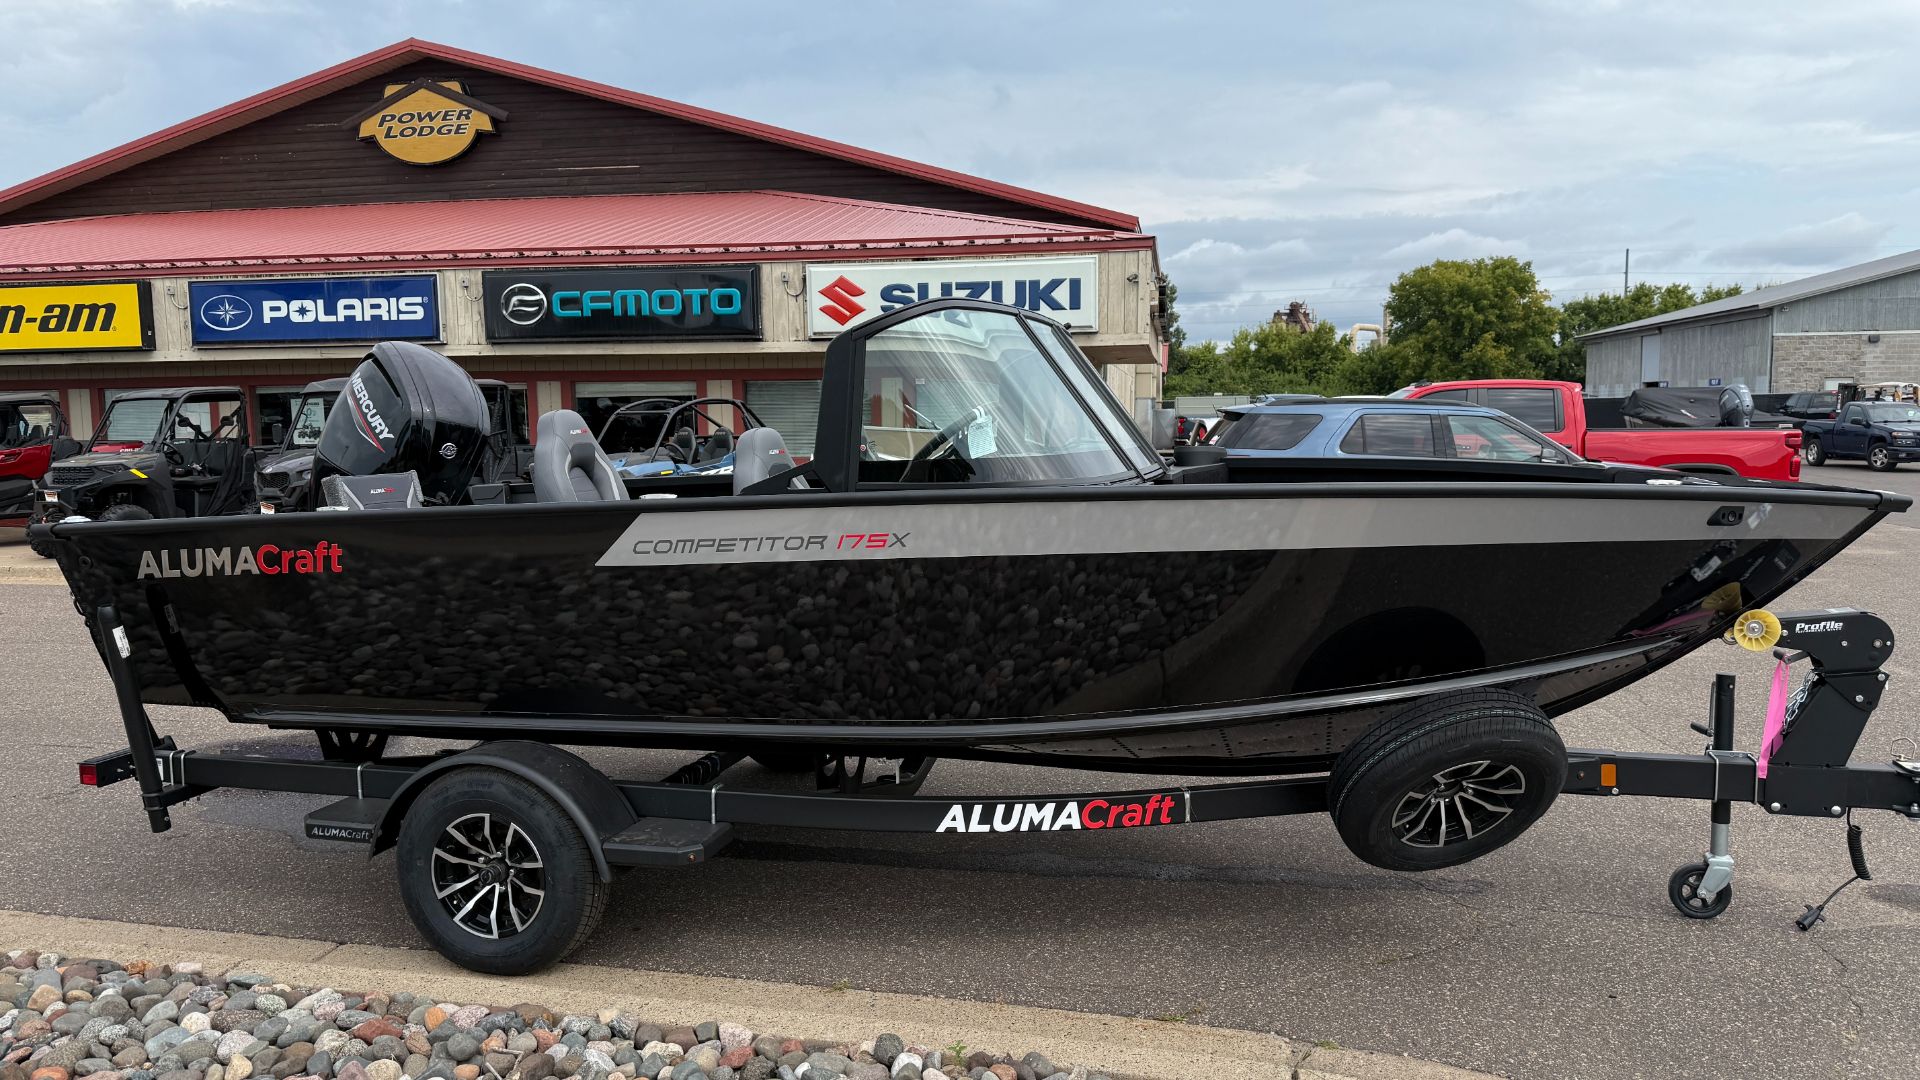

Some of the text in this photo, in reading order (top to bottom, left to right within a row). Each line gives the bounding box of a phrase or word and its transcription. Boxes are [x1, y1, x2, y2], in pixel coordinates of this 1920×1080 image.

[378, 109, 473, 128] POWER
[383, 123, 469, 139] LODGE
[262, 296, 423, 323] POLARIS
[552, 287, 742, 317] CFMOTO
[351, 371, 395, 440] MERCURY
[632, 532, 911, 554] COMPETITOR 175X
[137, 541, 343, 580] ALUMACraft
[1796, 621, 1844, 632] Profile
[935, 795, 1175, 833] ALUMACraft
[311, 826, 369, 840] ALUMACraft
